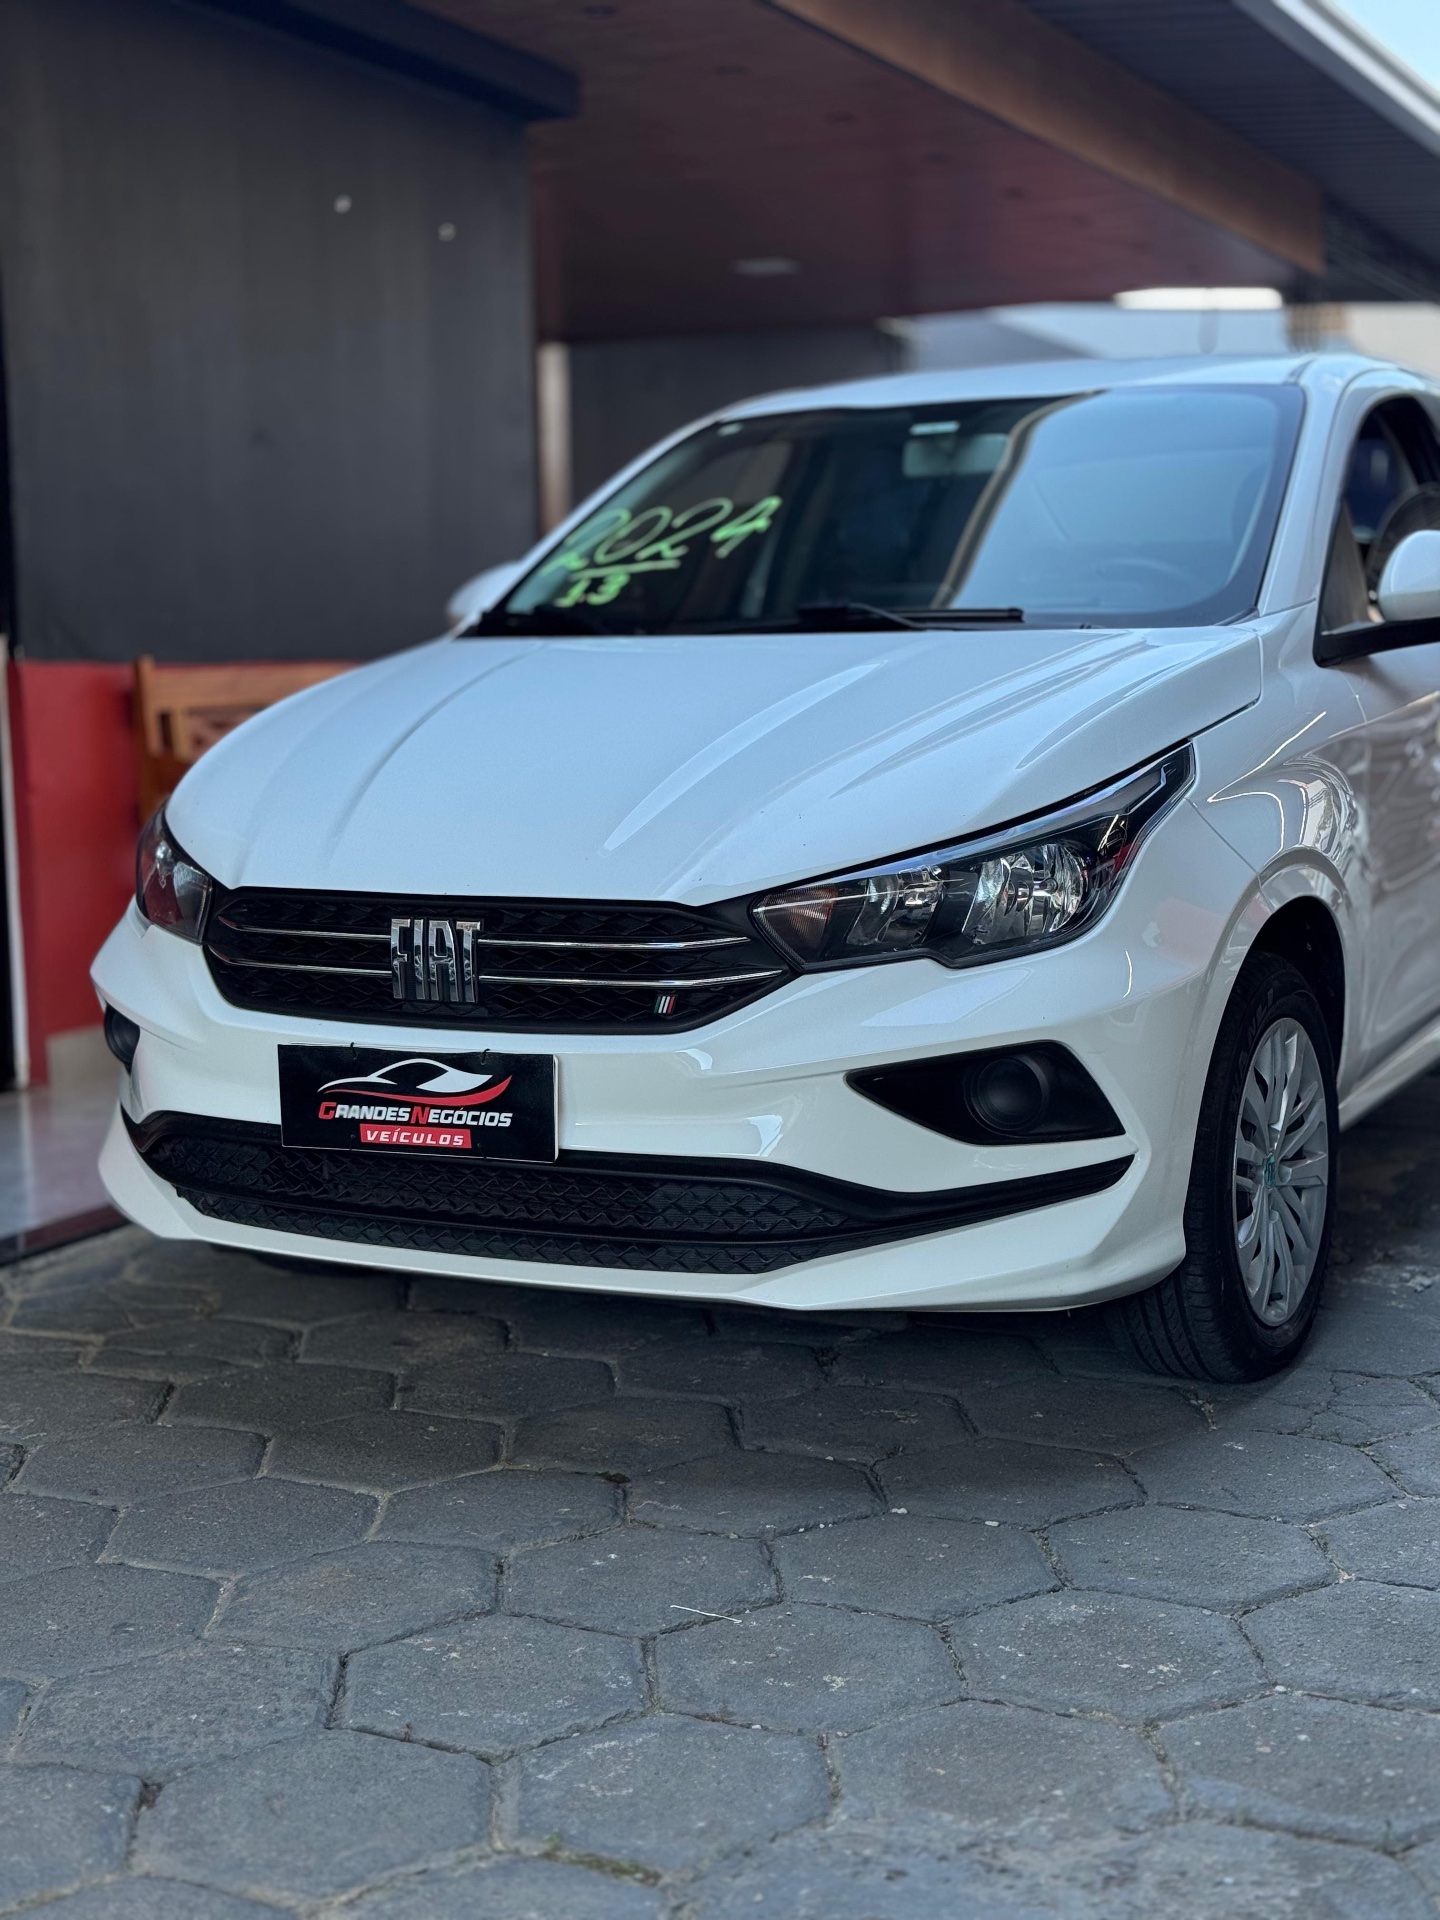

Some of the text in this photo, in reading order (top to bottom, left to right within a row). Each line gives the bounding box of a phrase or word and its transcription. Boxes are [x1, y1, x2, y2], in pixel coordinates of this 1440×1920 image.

[540, 496, 782, 577] 2024
[390, 918, 481, 1003] FIAT
[366, 1128, 464, 1146] VEÍCULOS
